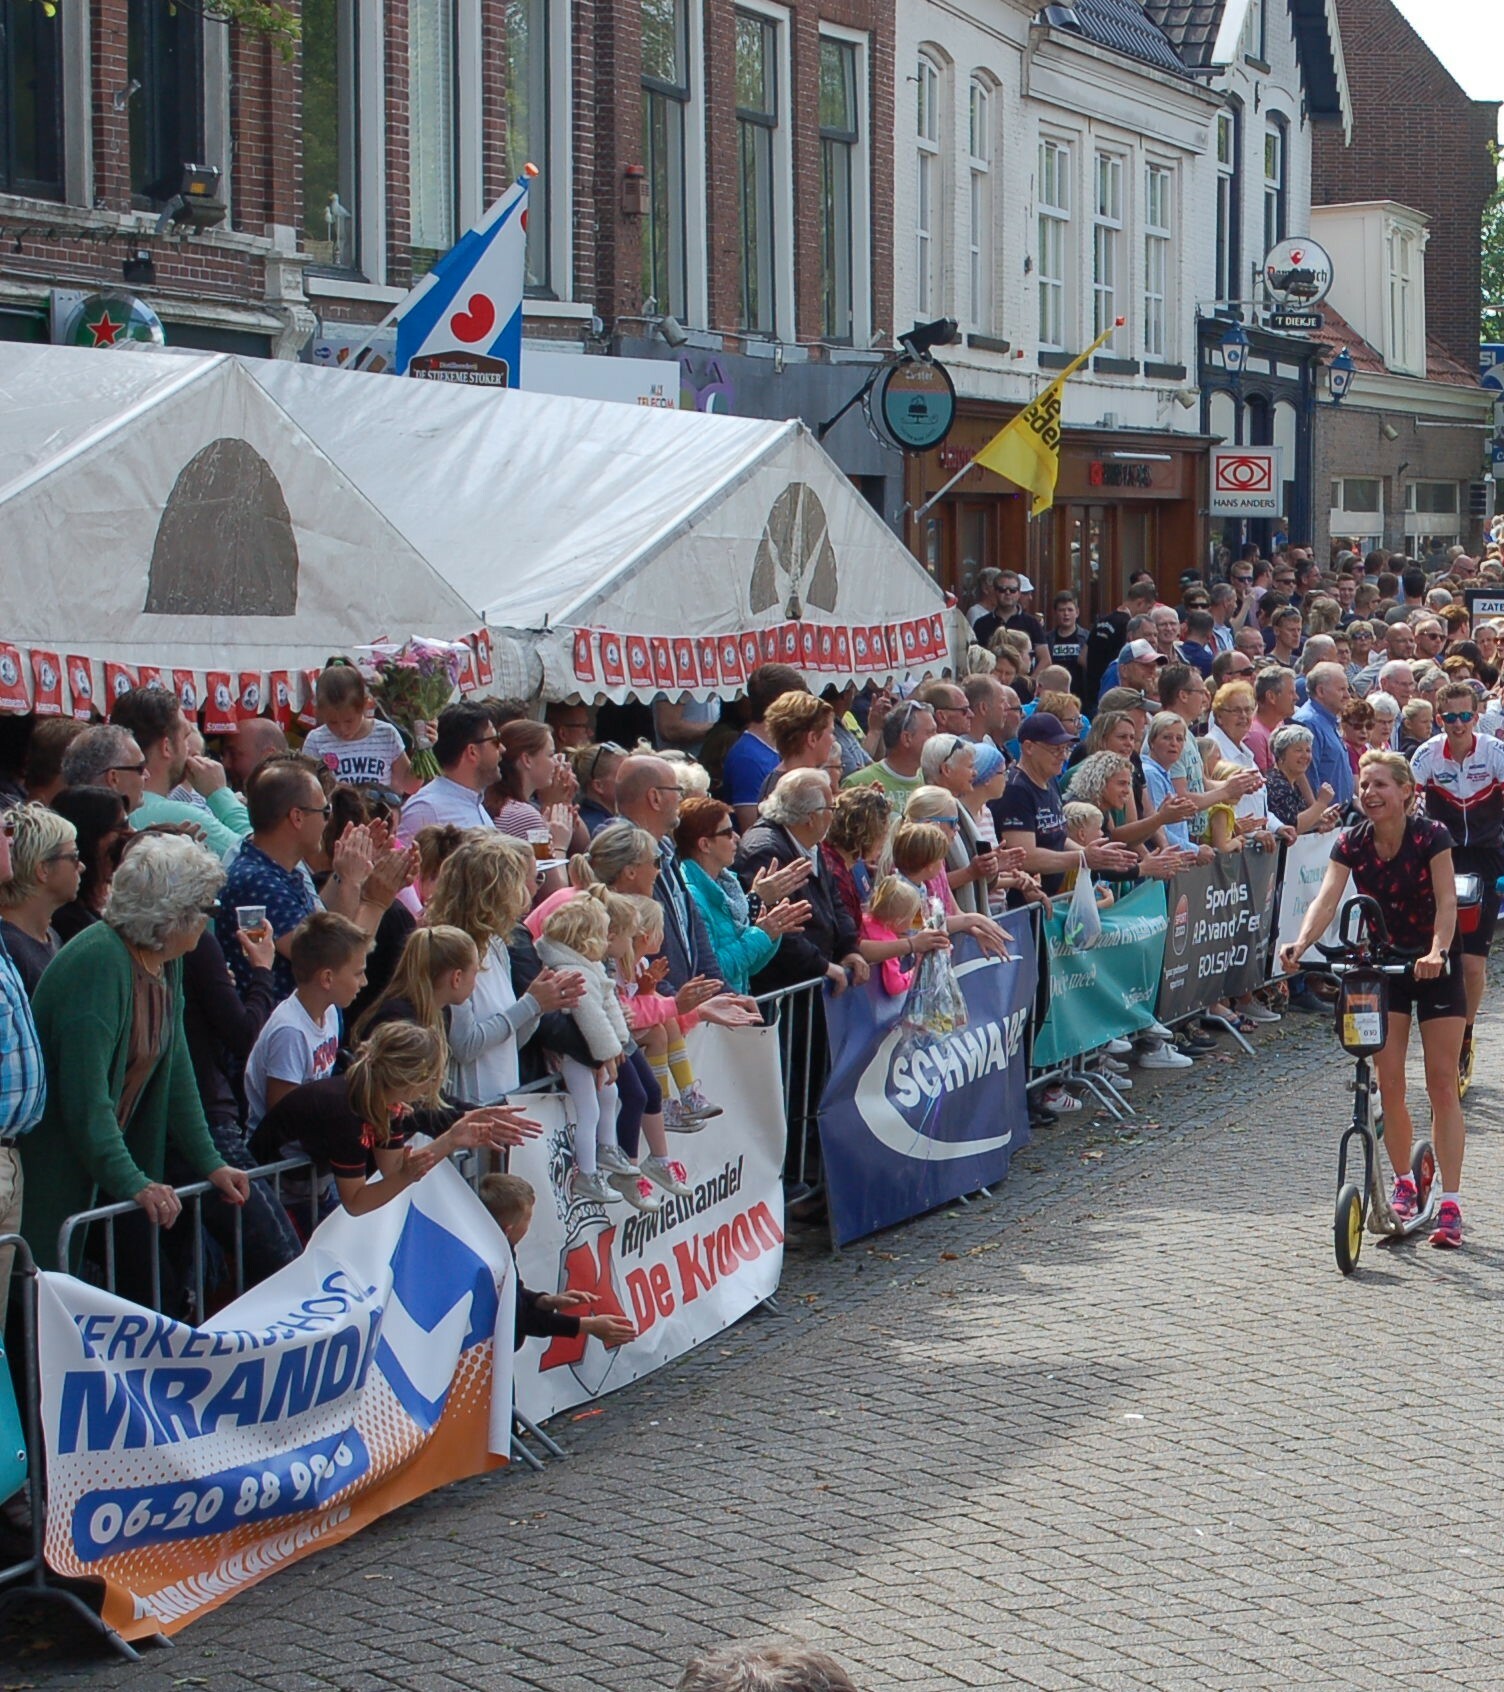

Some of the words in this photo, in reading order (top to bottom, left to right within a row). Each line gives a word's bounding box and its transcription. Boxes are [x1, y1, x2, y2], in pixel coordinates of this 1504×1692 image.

[1285, 316, 1317, 327] DIEKJE
[1213, 499, 1239, 508] HANS
[1240, 499, 1276, 509] ANDERS
[621, 1154, 744, 1259] Rijwielhandel
[625, 1262, 676, 1338] De
[672, 1200, 785, 1305] Kroon
[90, 1485, 224, 1545] 06-20
[233, 1470, 281, 1517] 88
